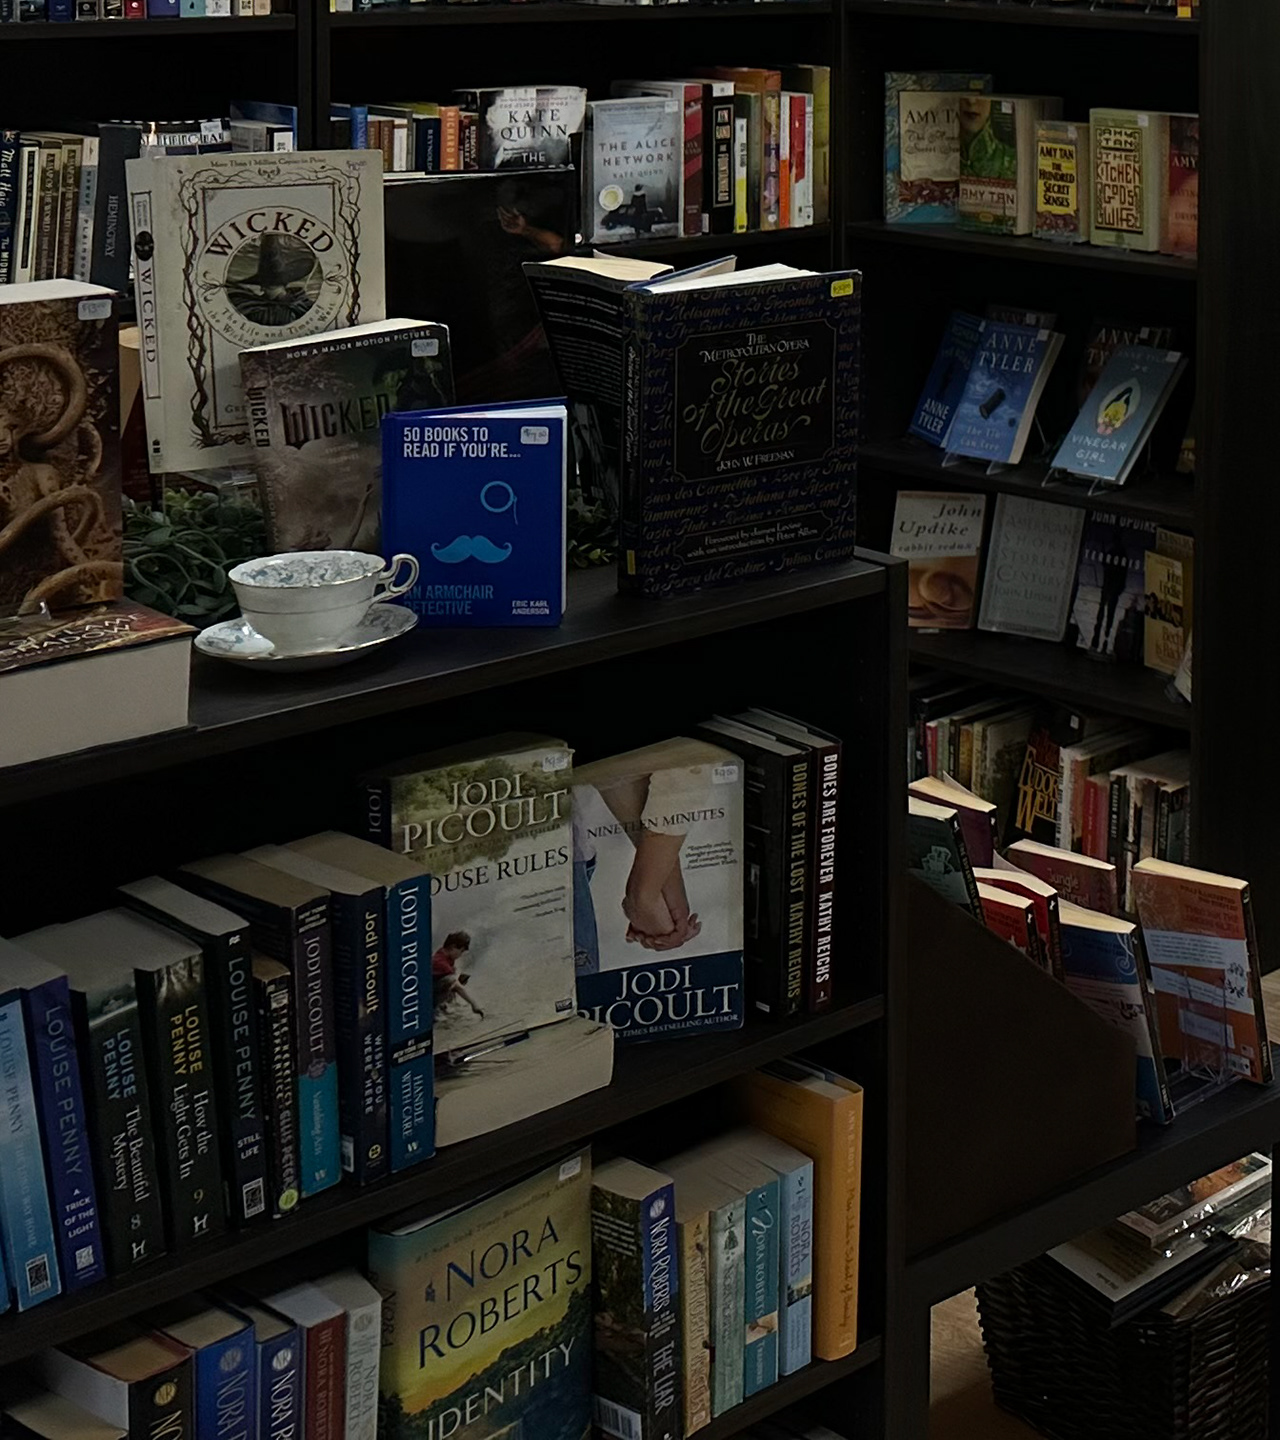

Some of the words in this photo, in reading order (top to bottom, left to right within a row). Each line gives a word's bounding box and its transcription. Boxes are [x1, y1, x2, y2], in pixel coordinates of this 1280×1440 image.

[508, 108, 560, 123] KATE
[501, 124, 568, 142] QUINN
[600, 141, 627, 152] THE
[636, 137, 676, 149] ALICE
[522, 151, 546, 163] THE
[603, 153, 674, 166] NETWORK
[1040, 146, 1057, 159] AMY
[1058, 148, 1074, 160] TAN
[1039, 168, 1075, 184] HUNDRED
[1043, 182, 1070, 196] SECRET
[1043, 194, 1070, 208] SENSES
[103, 195, 118, 257] HEMINGWAY
[206, 211, 334, 258] WICKED
[286, 350, 308, 360] NOW
[321, 343, 353, 355] MAJOR
[355, 338, 391, 350] MOTION
[393, 330, 431, 344] PICTURE
[699, 345, 776, 363] METROPOLITAN
[777, 339, 810, 353] OPERA
[747, 333, 766, 345] THE
[986, 332, 1037, 353] ANNE
[711, 356, 802, 395] Stories
[977, 350, 1035, 373] TYLER
[246, 386, 271, 449] WICKED
[683, 394, 714, 431] of
[716, 389, 753, 418] the
[753, 377, 827, 421] Great
[279, 393, 391, 450] WICKED
[403, 427, 420, 442] 50
[424, 427, 469, 442] BOOKS
[472, 427, 488, 442] TO
[403, 442, 440, 458] READ
[443, 442, 457, 458] IF
[460, 442, 521, 458] YOU'RE...
[701, 415, 811, 462] Operas
[934, 504, 982, 519] John
[899, 521, 969, 538] Updike
[425, 585, 494, 599] ARMCHAIR
[512, 600, 528, 608] ERIC
[530, 600, 548, 608] KARL
[512, 608, 549, 616] ANDERSON
[821, 754, 836, 797] BONES
[451, 773, 523, 812] JODI
[401, 787, 569, 854] PICOULT
[586, 817, 658, 839] NINETEEN
[662, 808, 726, 827] MINUTES
[820, 801, 835, 825] ARE
[818, 826, 834, 884] FOREVER
[430, 864, 488, 897] OUSE
[496, 847, 570, 880] RULES
[816, 892, 832, 933] KATHY
[814, 937, 830, 983] REICHS
[227, 957, 249, 1037] LOUISE
[619, 965, 692, 1001] JODI
[576, 984, 739, 1030] PICOULT
[234, 1047, 255, 1120] PENNY
[236, 1132, 261, 1148] STILL
[240, 1145, 260, 1159] LIFE
[64, 1214, 77, 1226] OF
[77, 1208, 95, 1220] THE
[65, 1197, 91, 1212] TRICK
[68, 1221, 95, 1238] LIGHT
[648, 1216, 669, 1256] NORA
[446, 1215, 559, 1302] NORA
[646, 1258, 669, 1312] ROBERTS
[418, 1249, 582, 1370] ROBERTS
[651, 1340, 674, 1373] THE
[428, 1337, 577, 1440] IDENTITY
[653, 1371, 675, 1415] LIAR
